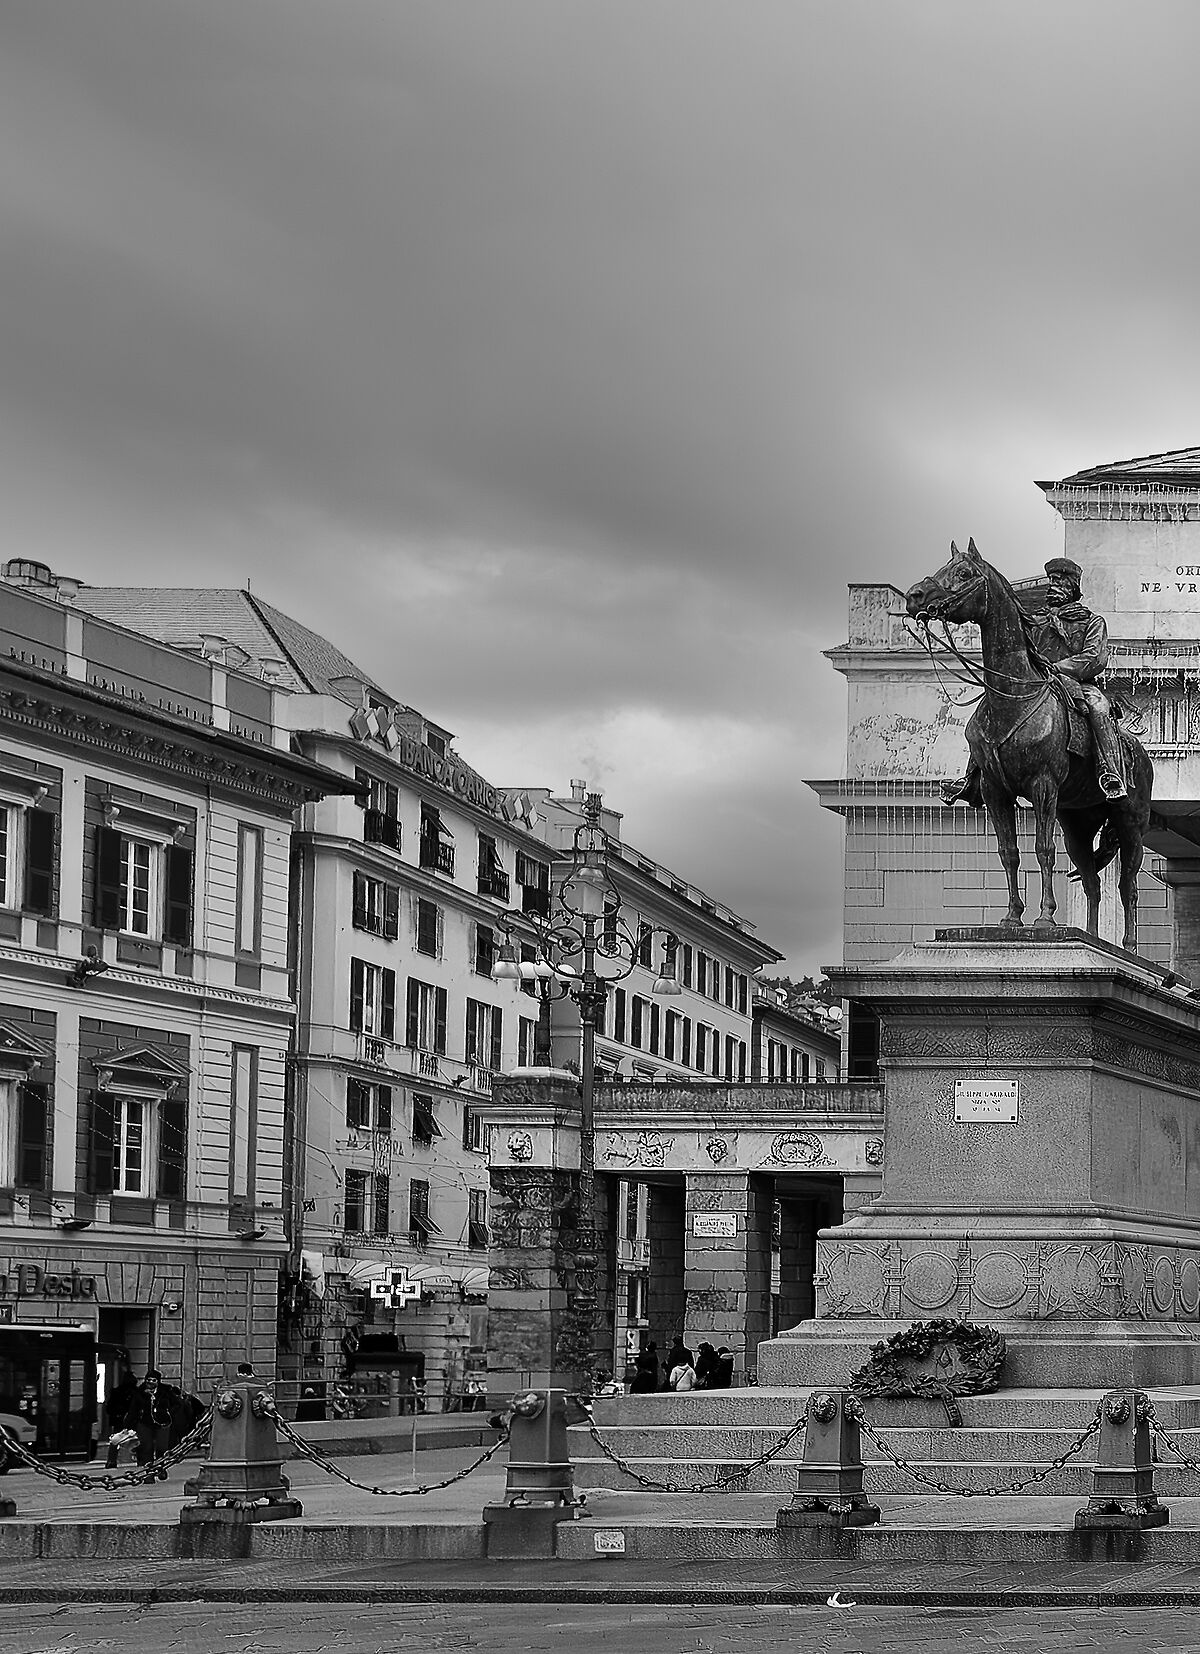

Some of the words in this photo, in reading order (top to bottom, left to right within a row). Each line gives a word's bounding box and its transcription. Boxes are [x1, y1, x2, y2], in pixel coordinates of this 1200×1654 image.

[1140, 582, 1163, 593] NE
[401, 738, 454, 787] BANCA
[14, 1264, 97, 1298] Desio
